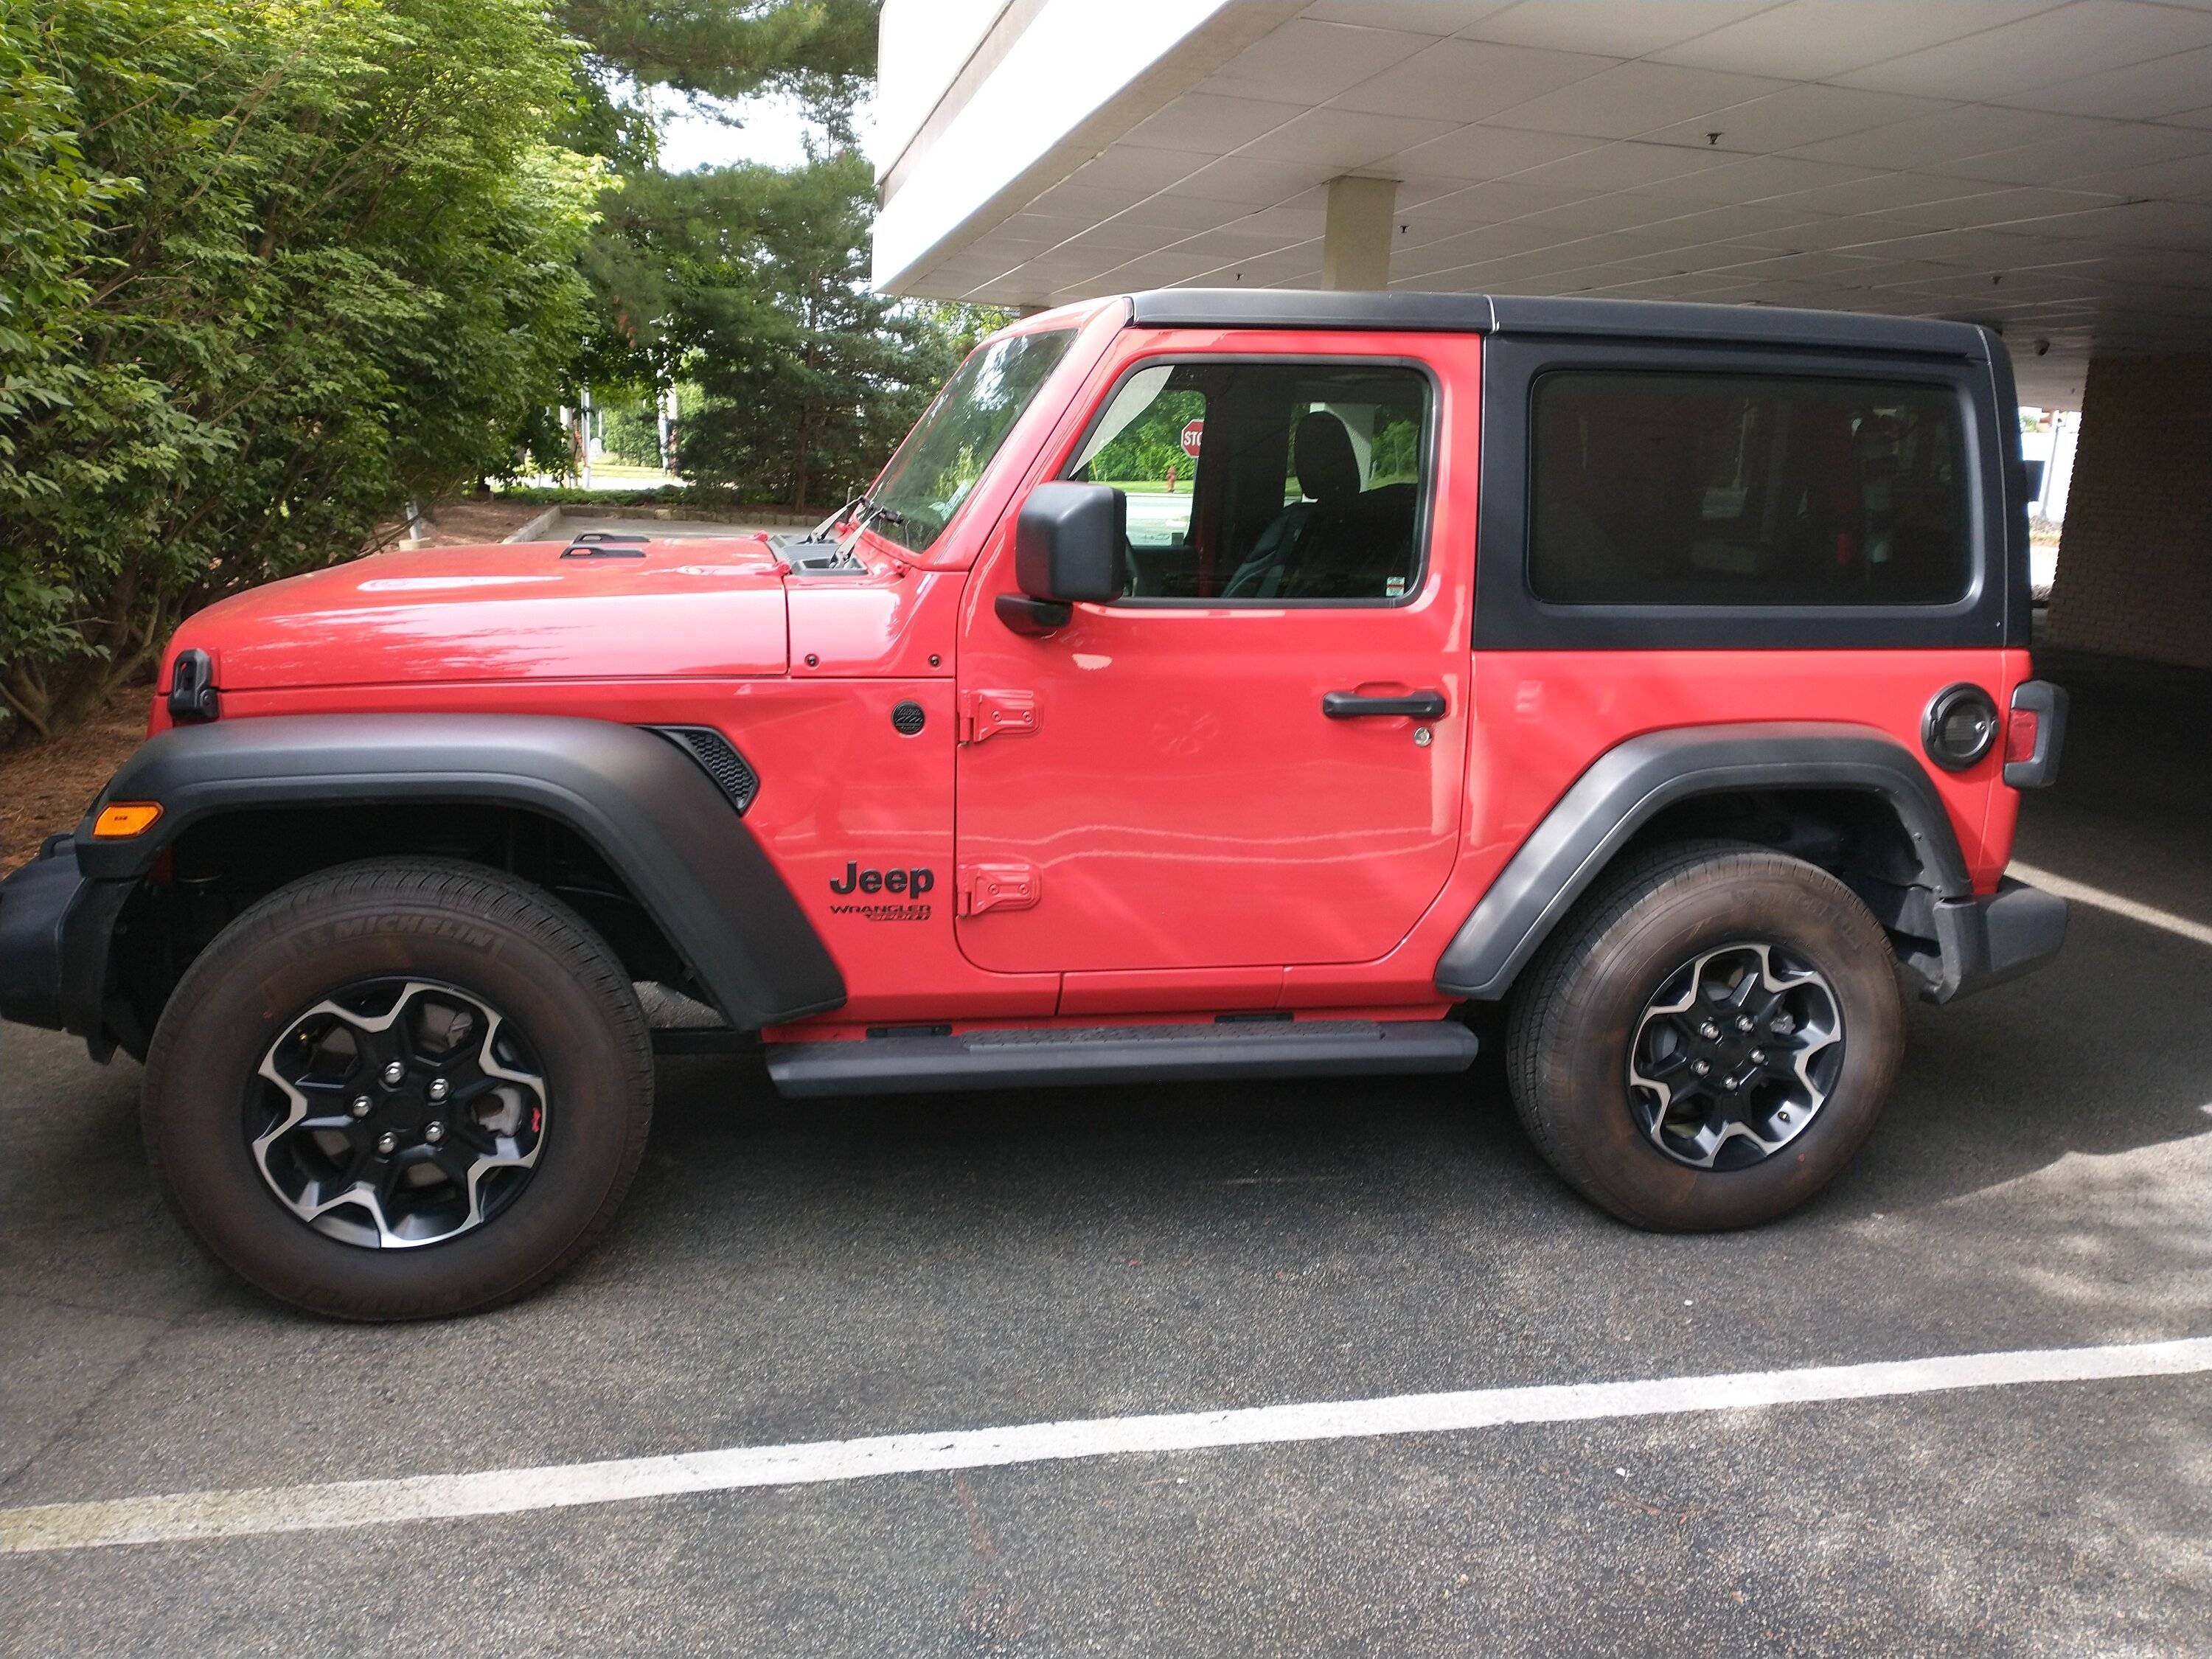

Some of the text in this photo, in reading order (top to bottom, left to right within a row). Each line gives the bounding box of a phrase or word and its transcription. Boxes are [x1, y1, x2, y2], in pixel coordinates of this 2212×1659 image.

[830, 860, 934, 899] Jeep
[830, 905, 931, 914] WRANGLER
[335, 915, 494, 947] MICHELIN
